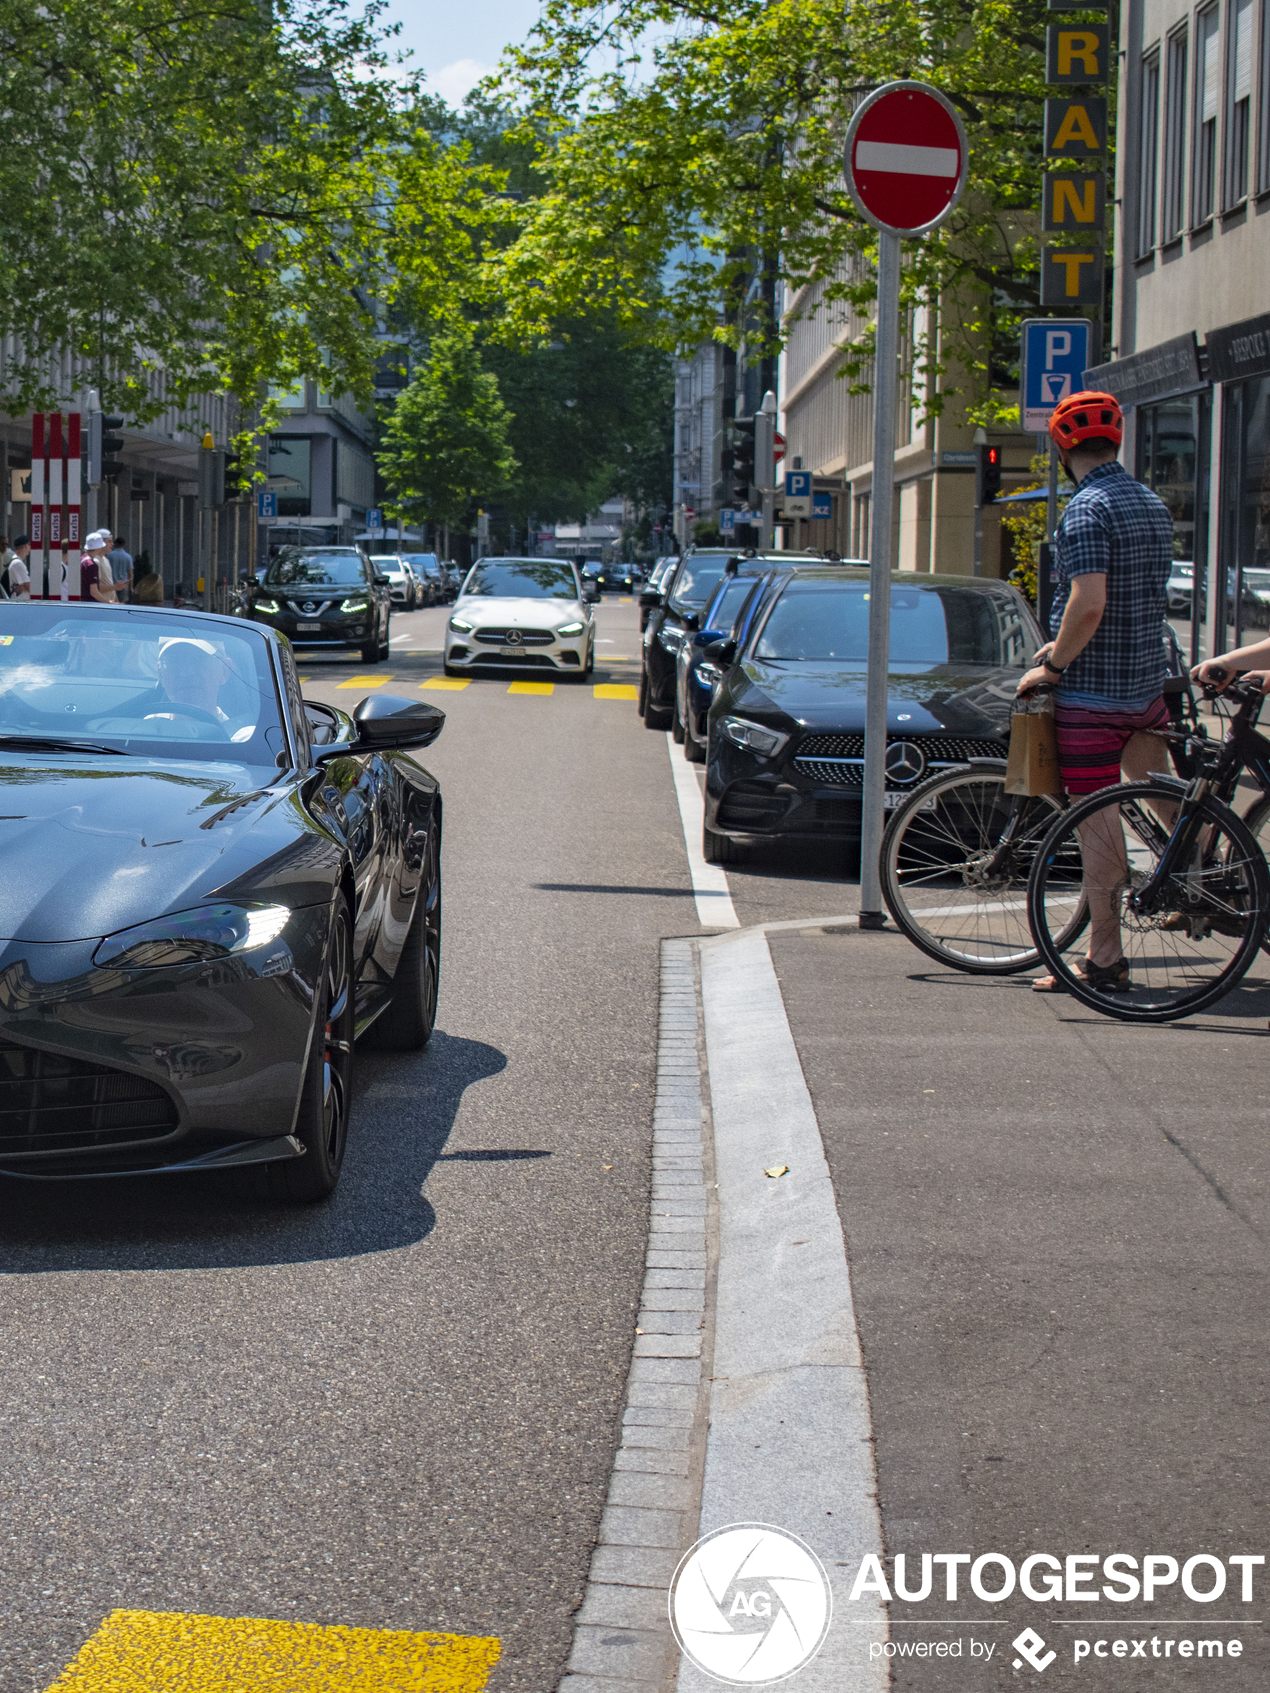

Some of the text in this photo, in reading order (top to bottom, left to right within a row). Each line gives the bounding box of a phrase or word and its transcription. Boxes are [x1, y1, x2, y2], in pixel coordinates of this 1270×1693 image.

[1052, 0, 1100, 297] RANT
[1045, 331, 1072, 370] P
[263, 494, 272, 507] P
[791, 476, 805, 495] P
[1120, 803, 1167, 857] OSS
